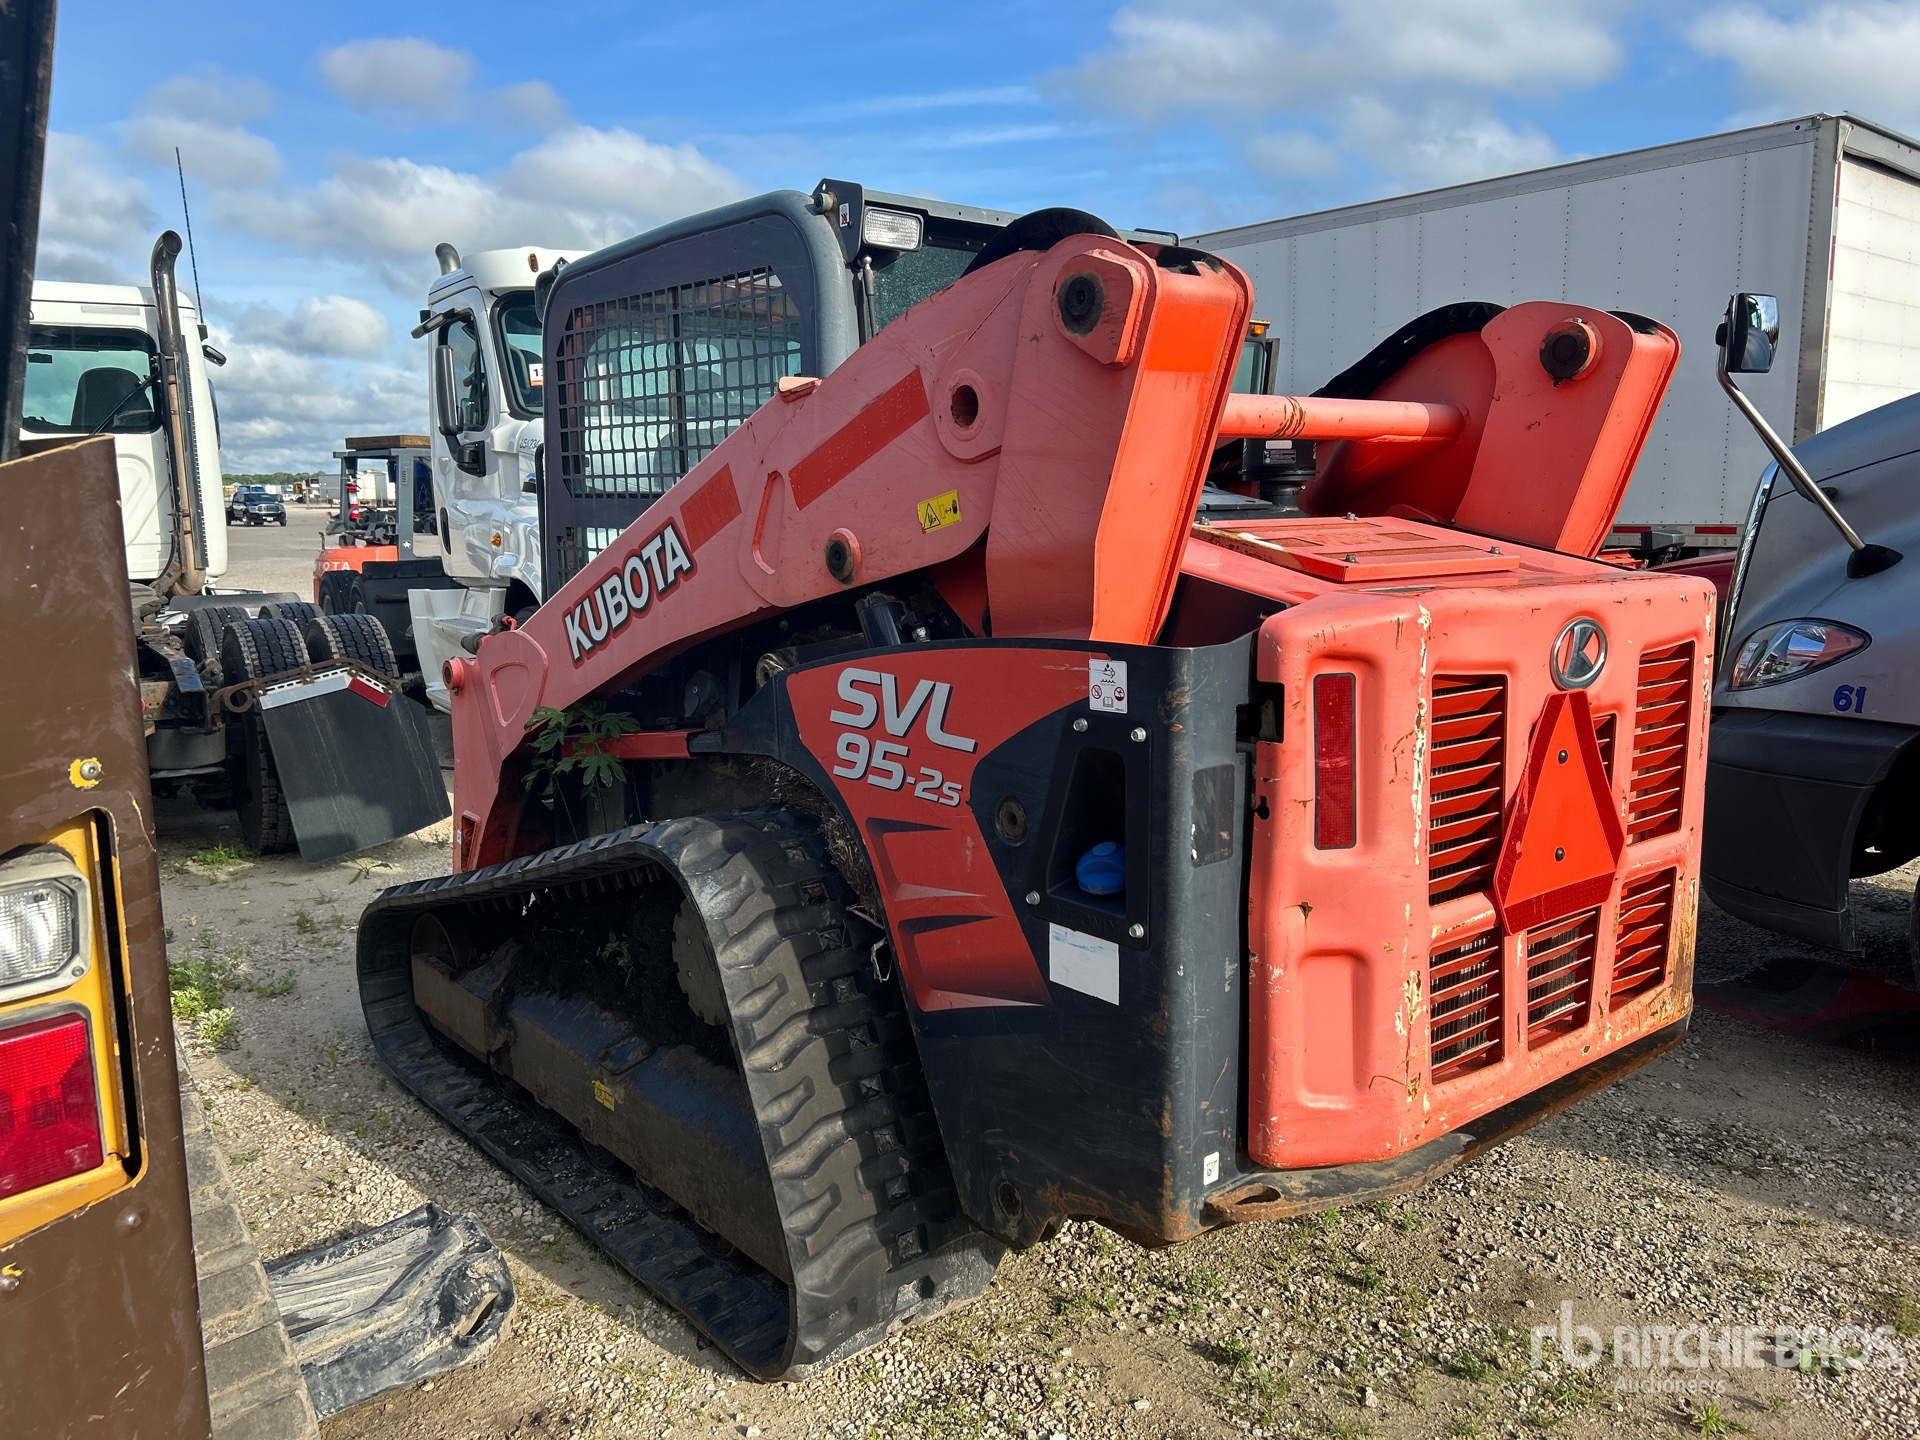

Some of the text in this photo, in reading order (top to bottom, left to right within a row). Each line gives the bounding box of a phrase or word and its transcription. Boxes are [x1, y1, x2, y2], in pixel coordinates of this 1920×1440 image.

[564, 525, 692, 662] KUBOTA
[829, 667, 979, 753] SVL
[1833, 684, 1867, 713] 61
